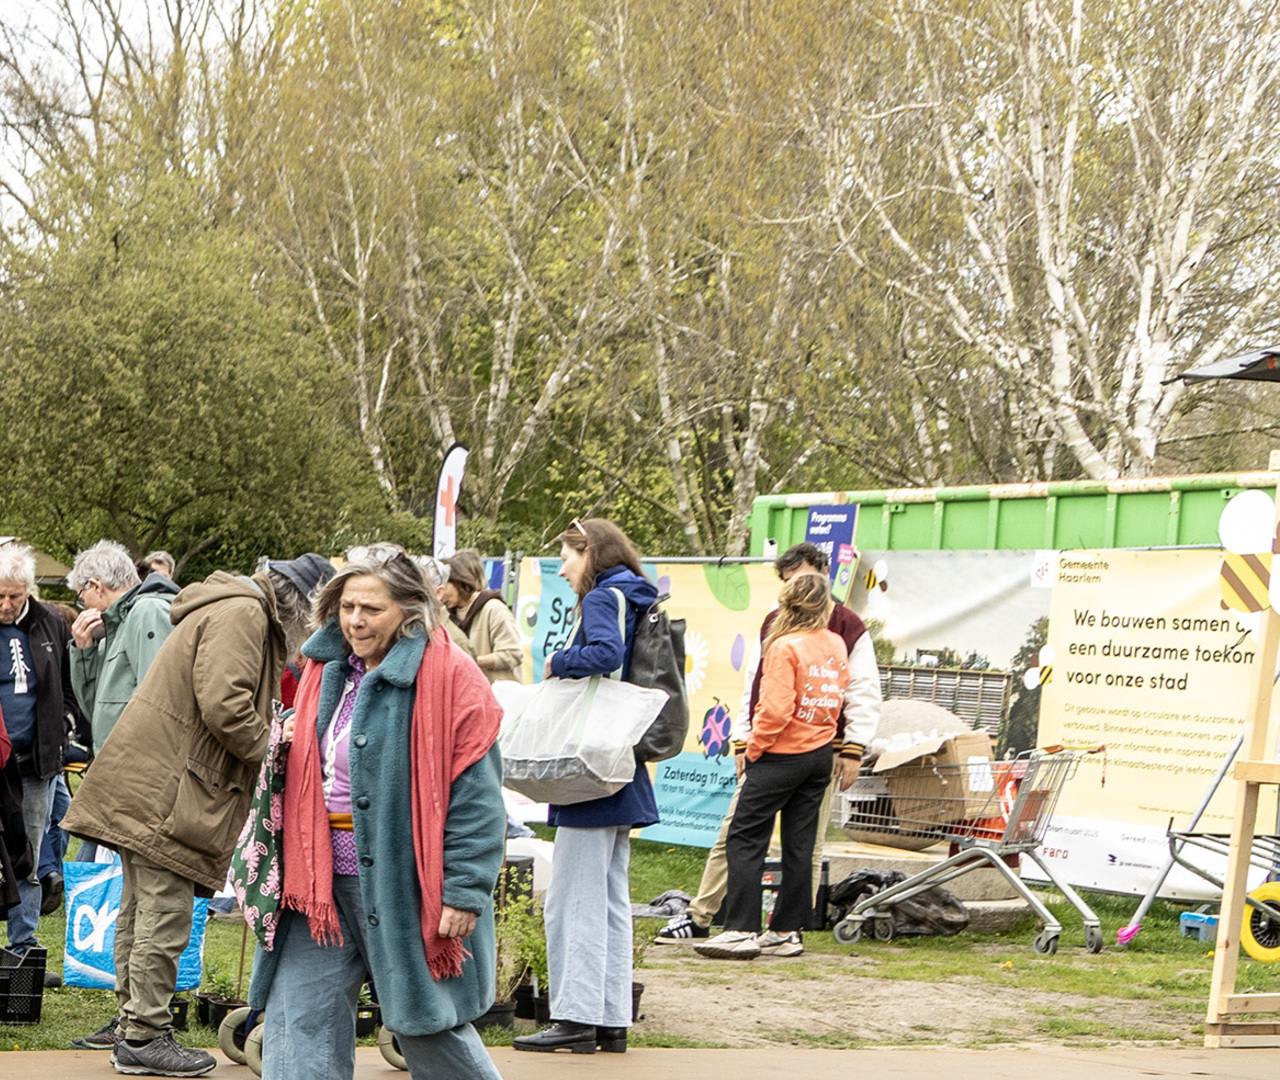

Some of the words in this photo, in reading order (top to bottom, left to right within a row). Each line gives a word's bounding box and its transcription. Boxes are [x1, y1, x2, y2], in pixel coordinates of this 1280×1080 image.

[810, 511, 848, 527] Programma
[1059, 558, 1109, 570] Gemeente
[1058, 572, 1101, 584] Haarlem
[1073, 609, 1096, 627] We
[1100, 610, 1166, 631] bouwen
[1172, 617, 1230, 633] samen
[1069, 641, 1097, 657] een
[1101, 639, 1190, 661] duurzame
[1195, 644, 1256, 665] toekom
[809, 665, 820, 678] Ik
[1066, 671, 1101, 684] voor
[1105, 673, 1145, 688] onze
[1149, 673, 1188, 690] stad
[796, 707, 817, 723] bij
[1076, 705, 1106, 716] gebouw
[1107, 708, 1129, 717] wordt
[1143, 710, 1180, 721] circulaire
[1182, 713, 1192, 721] en
[1193, 713, 1235, 725] duurzame
[1103, 723, 1144, 736] Binnenkort
[1145, 728, 1174, 738] kunnen
[1175, 731, 1211, 741] inwoners
[1123, 742, 1162, 755] informatie
[1164, 746, 1174, 754] en
[1175, 748, 1211, 759] inspiratie
[663, 766, 708, 787] Zaterdag
[710, 772, 718, 785] 11
[718, 773, 738, 789] apri
[686, 810, 723, 820] programma
